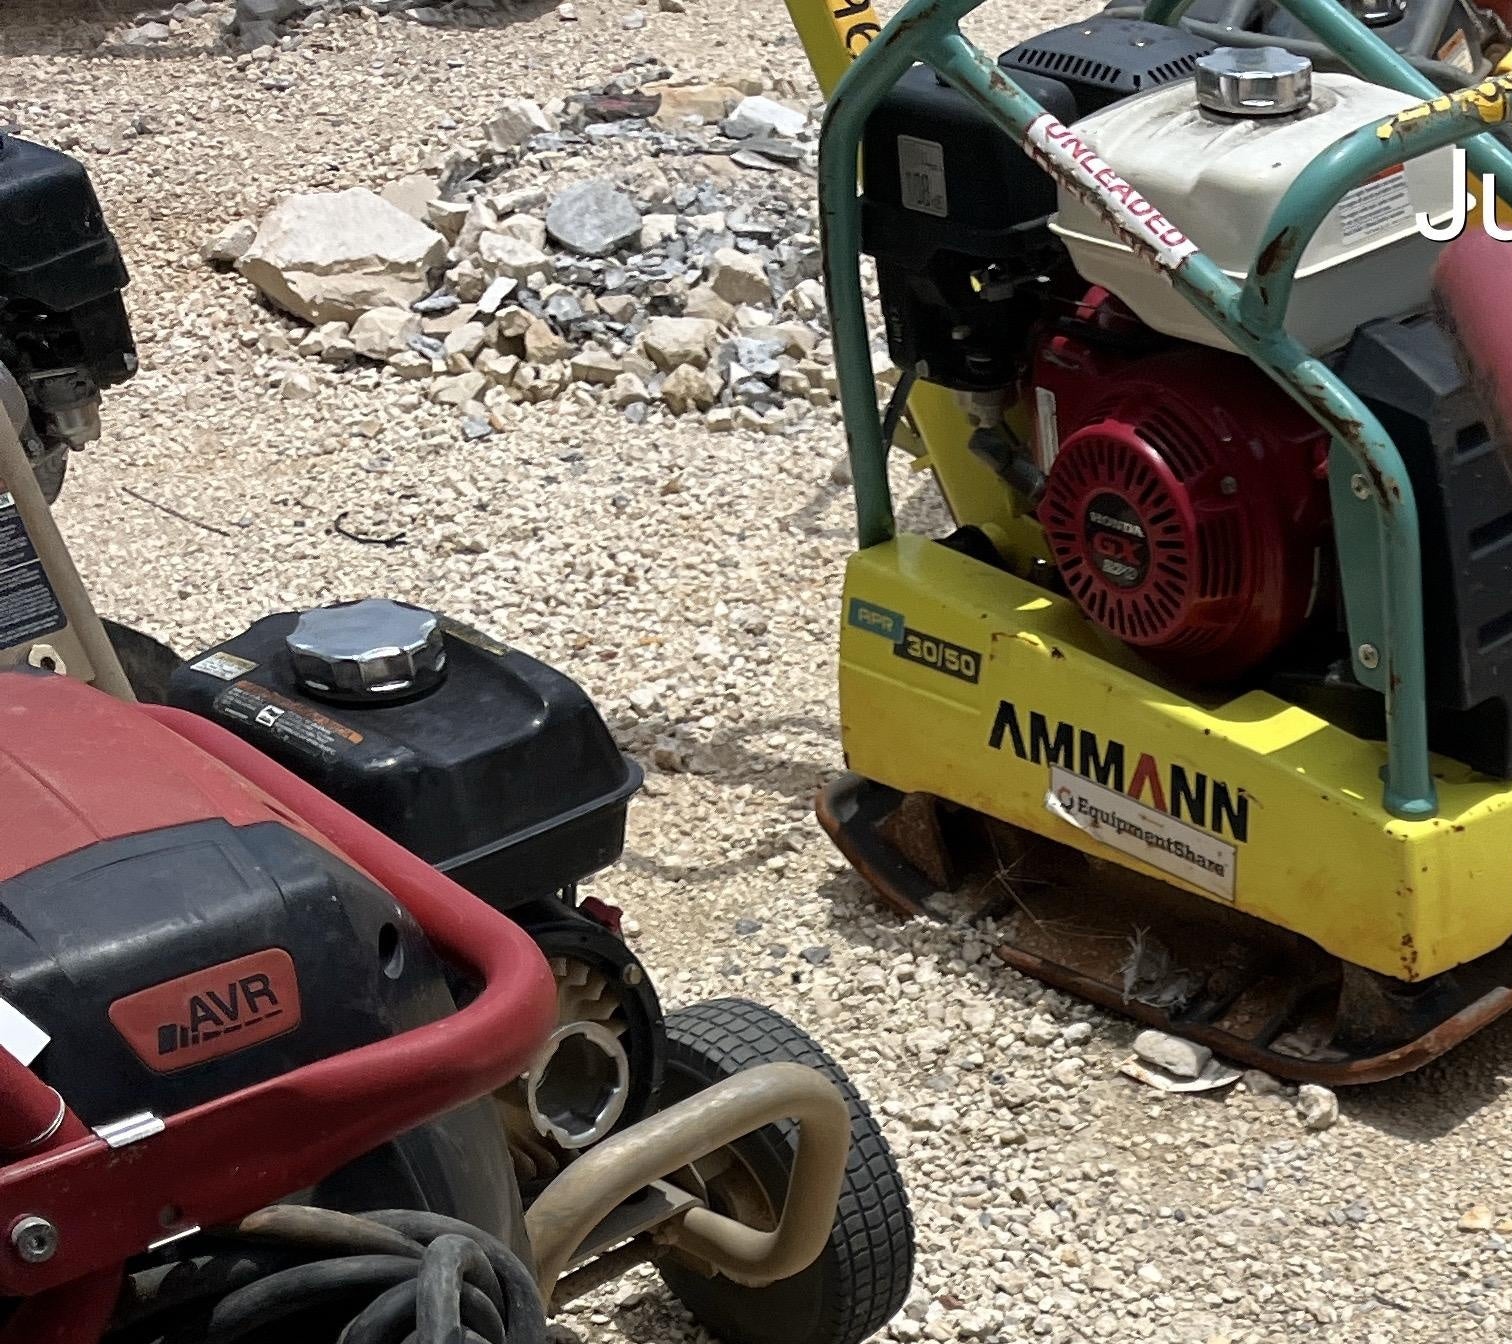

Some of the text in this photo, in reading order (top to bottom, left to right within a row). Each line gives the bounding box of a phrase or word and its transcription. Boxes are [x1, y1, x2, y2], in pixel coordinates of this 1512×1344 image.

[1045, 122, 1188, 247] UNLEADED
[1089, 511, 1146, 538] HONDA
[988, 700, 1249, 843] AMMANN
[1077, 796, 1226, 877] EquipmentShare
[189, 973, 279, 1034] AVR
